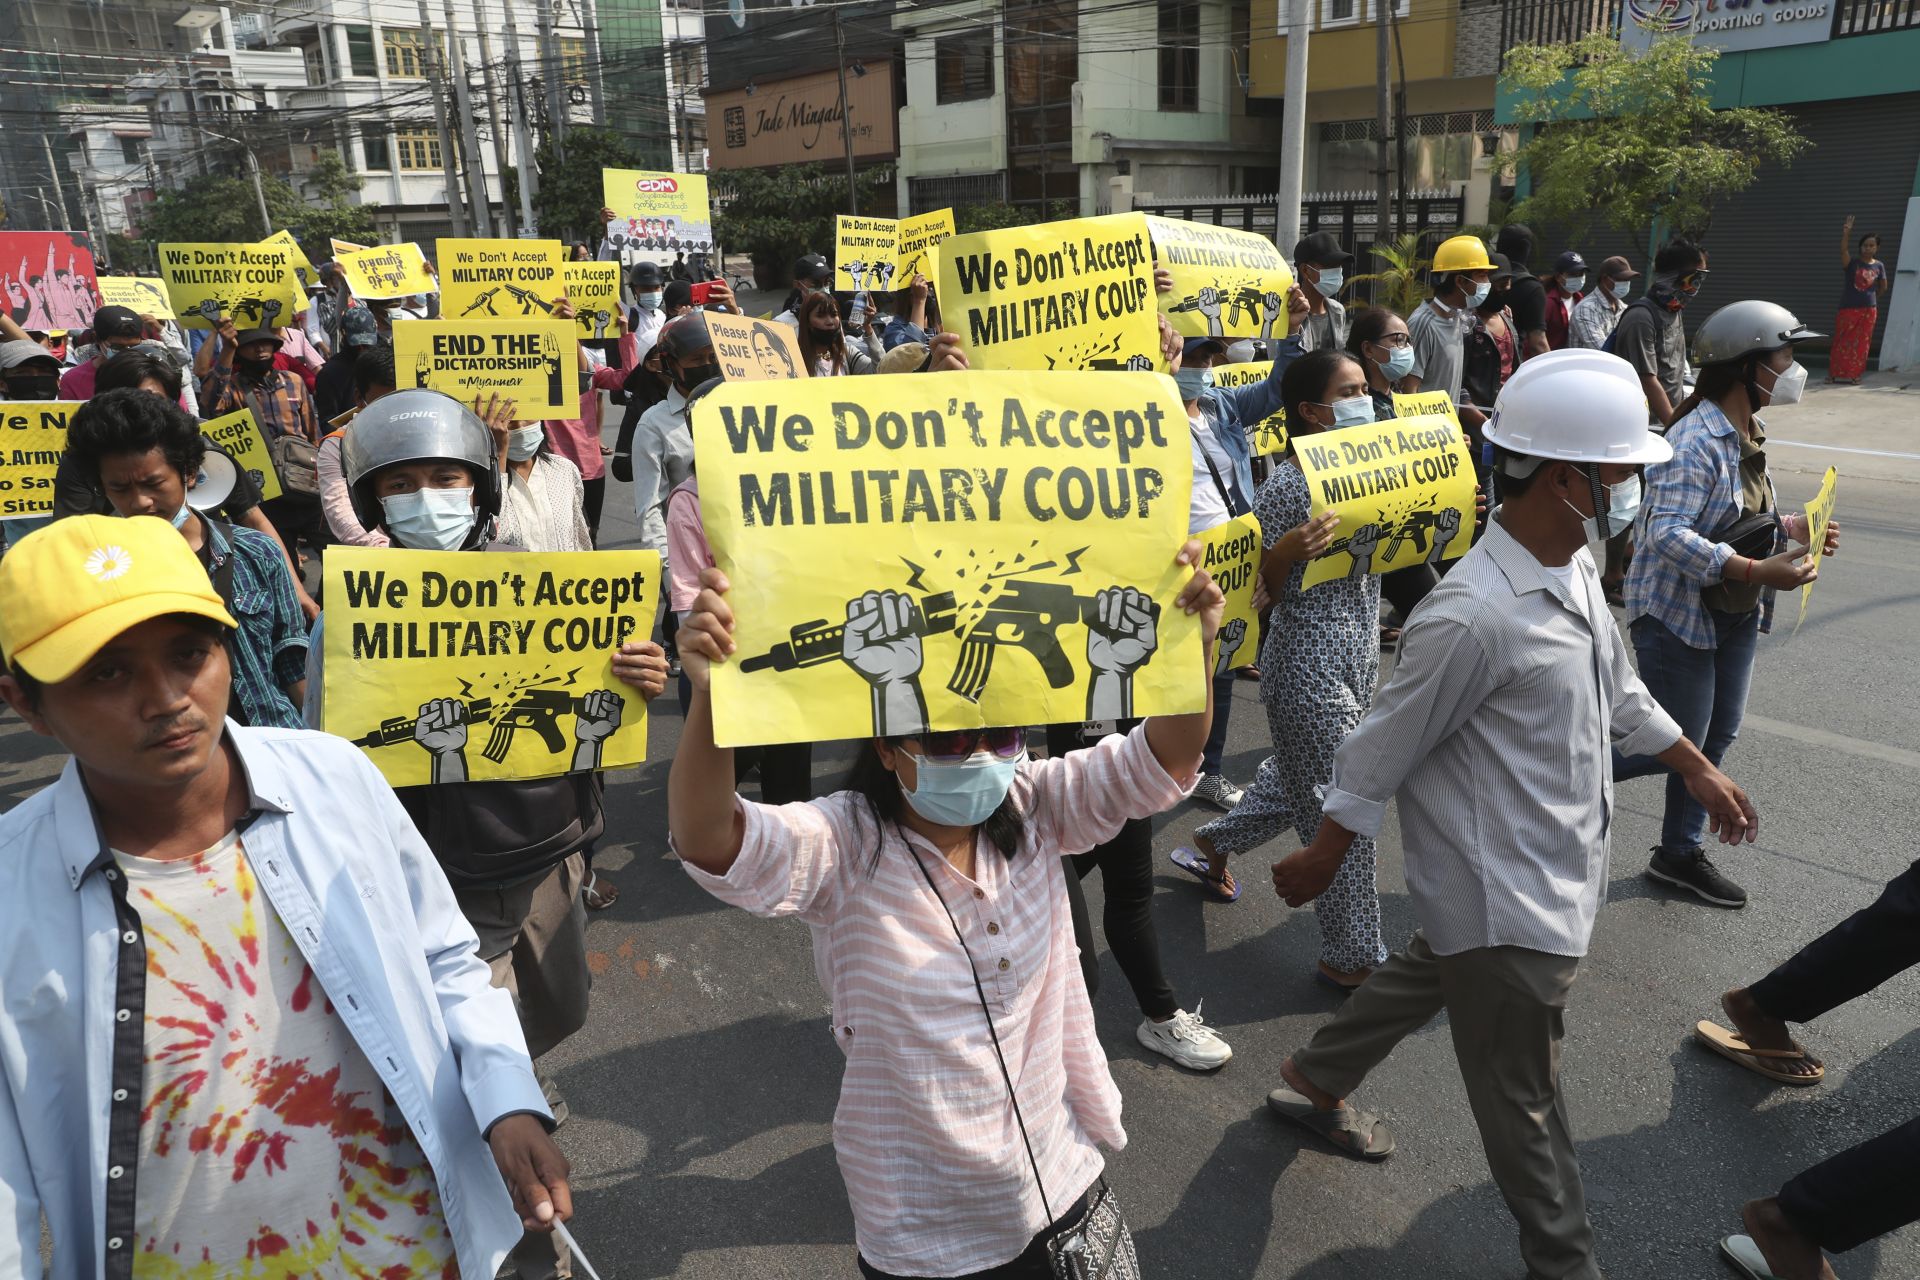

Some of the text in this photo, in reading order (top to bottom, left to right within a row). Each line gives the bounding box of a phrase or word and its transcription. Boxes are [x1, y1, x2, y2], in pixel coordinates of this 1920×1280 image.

[1694, 12, 1763, 33] SPORTING
[1772, 4, 1827, 23] GOODS
[752, 95, 786, 138] Jade
[637, 180, 675, 192] CDM
[841, 219, 896, 234] We Don't Accept
[905, 226, 922, 238] Don't
[924, 220, 946, 233] Accept
[841, 236, 895, 248] MILITARY COUP
[1154, 222, 1274, 253] We Don't Accept
[898, 238, 928, 256] ILITARY
[166, 250, 286, 269] We Don't Accept
[456, 252, 474, 263] We
[479, 251, 507, 263] Don't
[512, 251, 548, 264] Accept
[955, 233, 1146, 295] We Don't Accept
[1166, 244, 1278, 272] MILITARY COUP
[171, 269, 285, 284] MILITARY COUP
[452, 267, 554, 282] MILITARY COUP
[564, 268, 616, 284] n't Accept
[585, 284, 614, 297] COUP
[968, 277, 1148, 348] MILITARY COUP
[711, 322, 748, 340] Please
[433, 334, 541, 356] END THE
[718, 343, 752, 359] SAVE
[434, 357, 541, 371] DICTATORSHIP
[725, 363, 746, 378] Our
[466, 375, 523, 390] Myanmar
[1219, 372, 1238, 387] We
[389, 410, 440, 423] SONIC
[1418, 400, 1451, 416] Accept
[0, 412, 29, 430] e
[719, 397, 1169, 464] We Don't Accept
[224, 437, 254, 457] OUP
[1304, 424, 1457, 472] We Don't Accept
[0, 480, 14, 491] o
[1321, 452, 1460, 506] MILITARY COUP
[738, 465, 1166, 528] MILITARY COUP
[3, 499, 54, 513] Situ
[1203, 528, 1256, 569] Accept
[342, 570, 645, 614] We Don't Accept
[352, 615, 637, 660] MILITARY COUP
